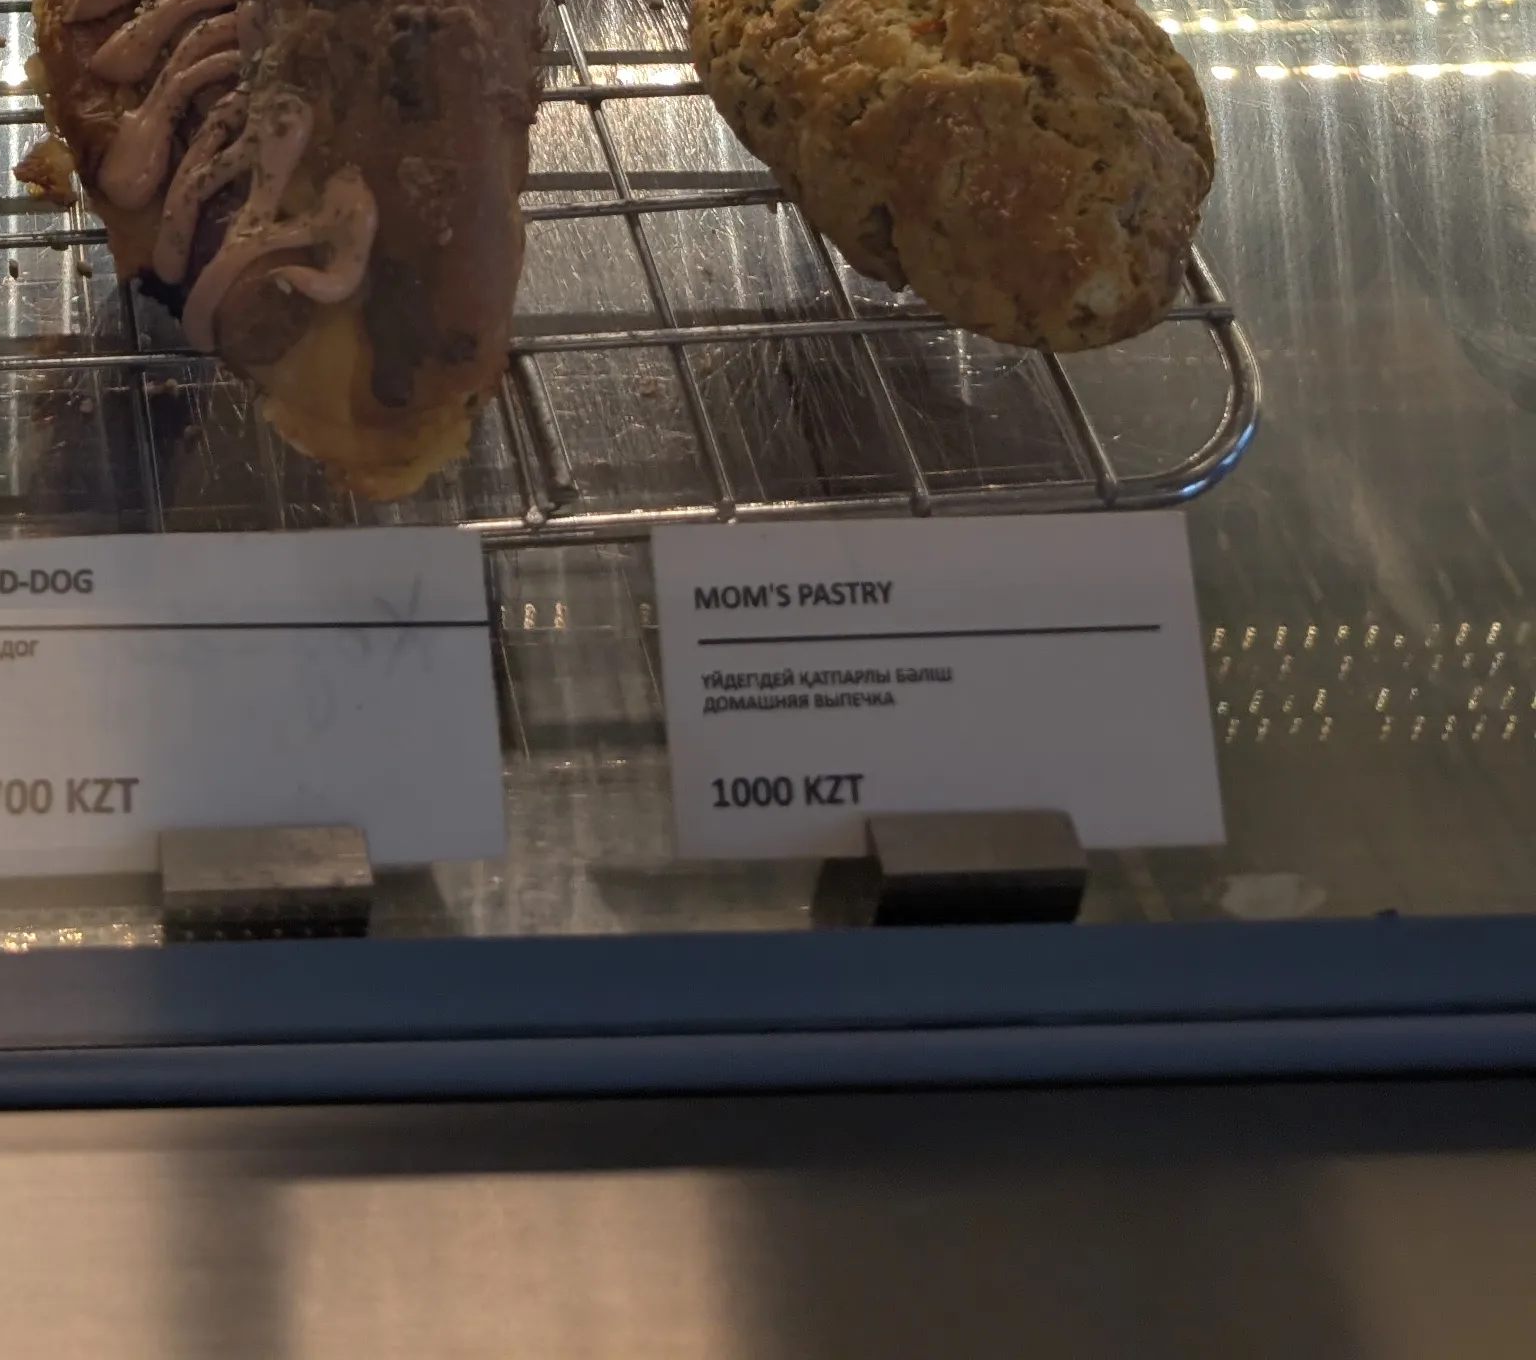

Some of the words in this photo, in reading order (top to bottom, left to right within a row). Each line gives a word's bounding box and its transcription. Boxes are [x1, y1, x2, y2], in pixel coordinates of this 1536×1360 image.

[694, 584, 791, 610] MOM'S
[799, 581, 892, 605] PASTRY
[703, 693, 809, 714] ДОМАШНЯЯ
[814, 691, 895, 710] ВЫПЕЧКА
[66, 778, 140, 814] KZT
[712, 777, 793, 808] 1000
[805, 774, 864, 805] KZT
